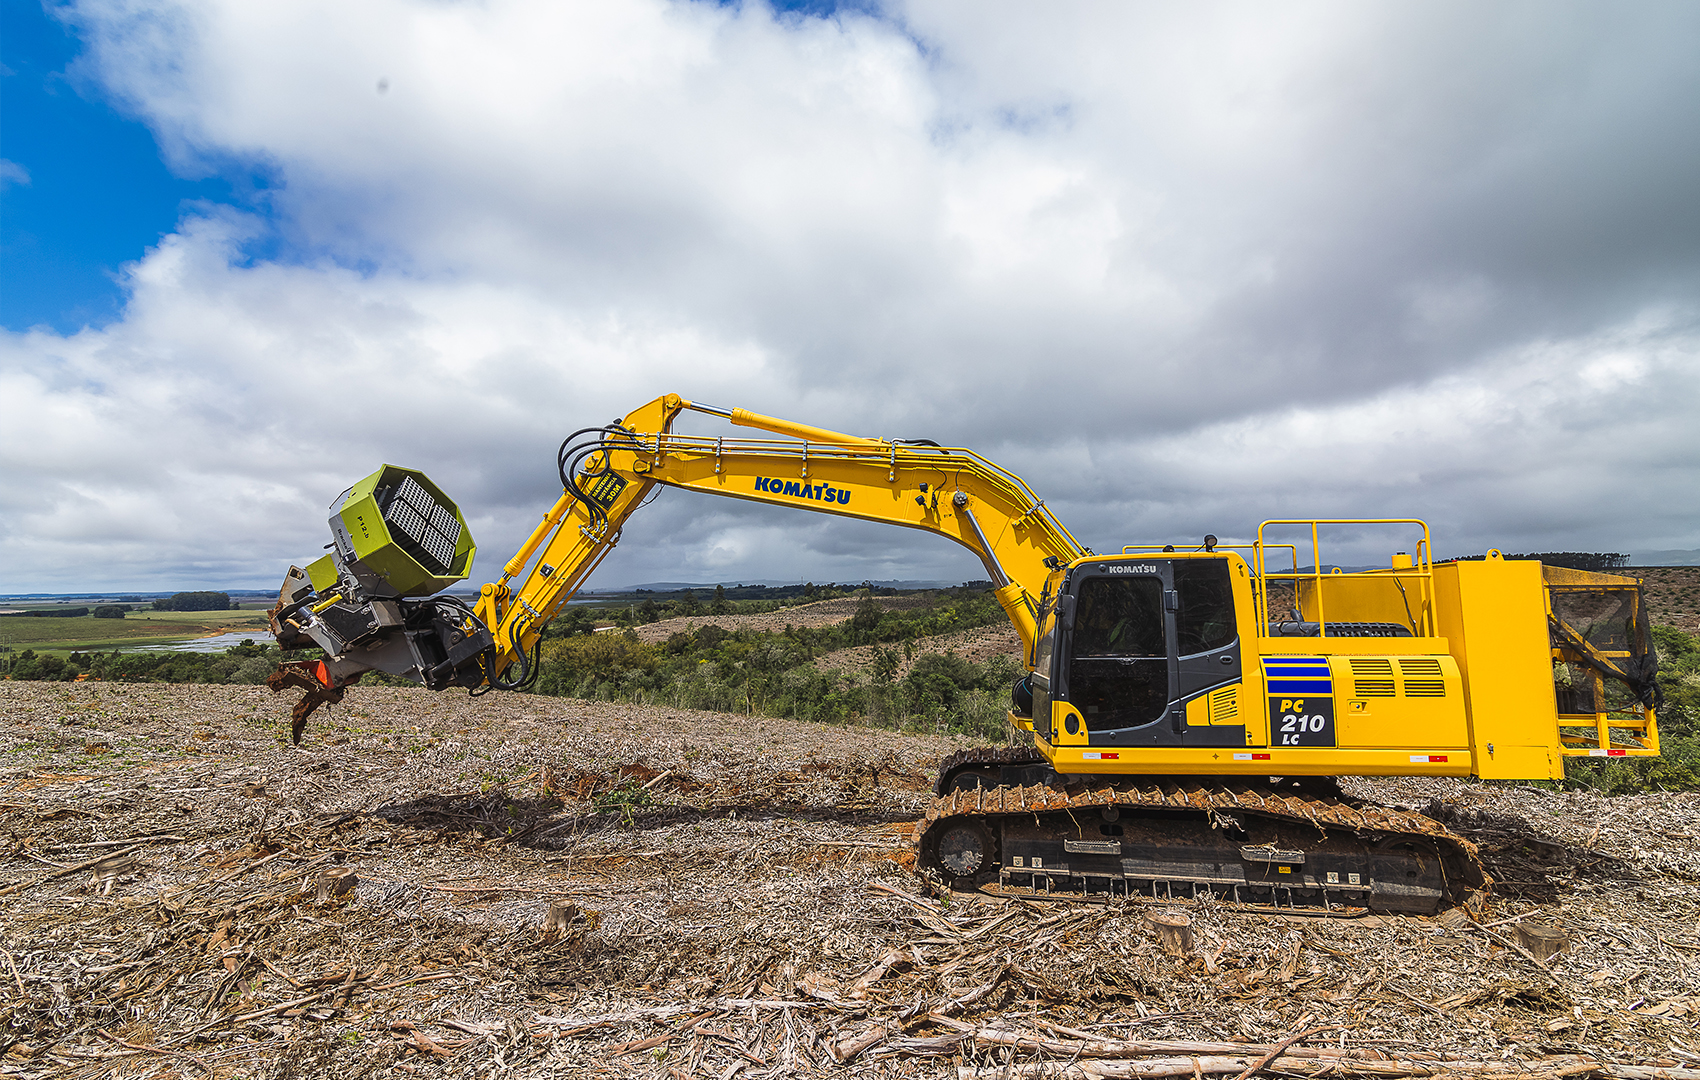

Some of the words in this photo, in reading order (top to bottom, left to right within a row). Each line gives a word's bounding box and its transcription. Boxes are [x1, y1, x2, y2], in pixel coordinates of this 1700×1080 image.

[591, 472, 612, 497] MANTENHA
[597, 477, 617, 501] DISTÂNCIA
[606, 484, 621, 501] 30M
[754, 476, 851, 505] KOMATSU
[1109, 564, 1157, 574] KOMATSU
[1280, 699, 1305, 713] PC
[1280, 714, 1325, 733] 210
[1282, 734, 1300, 746] LC
